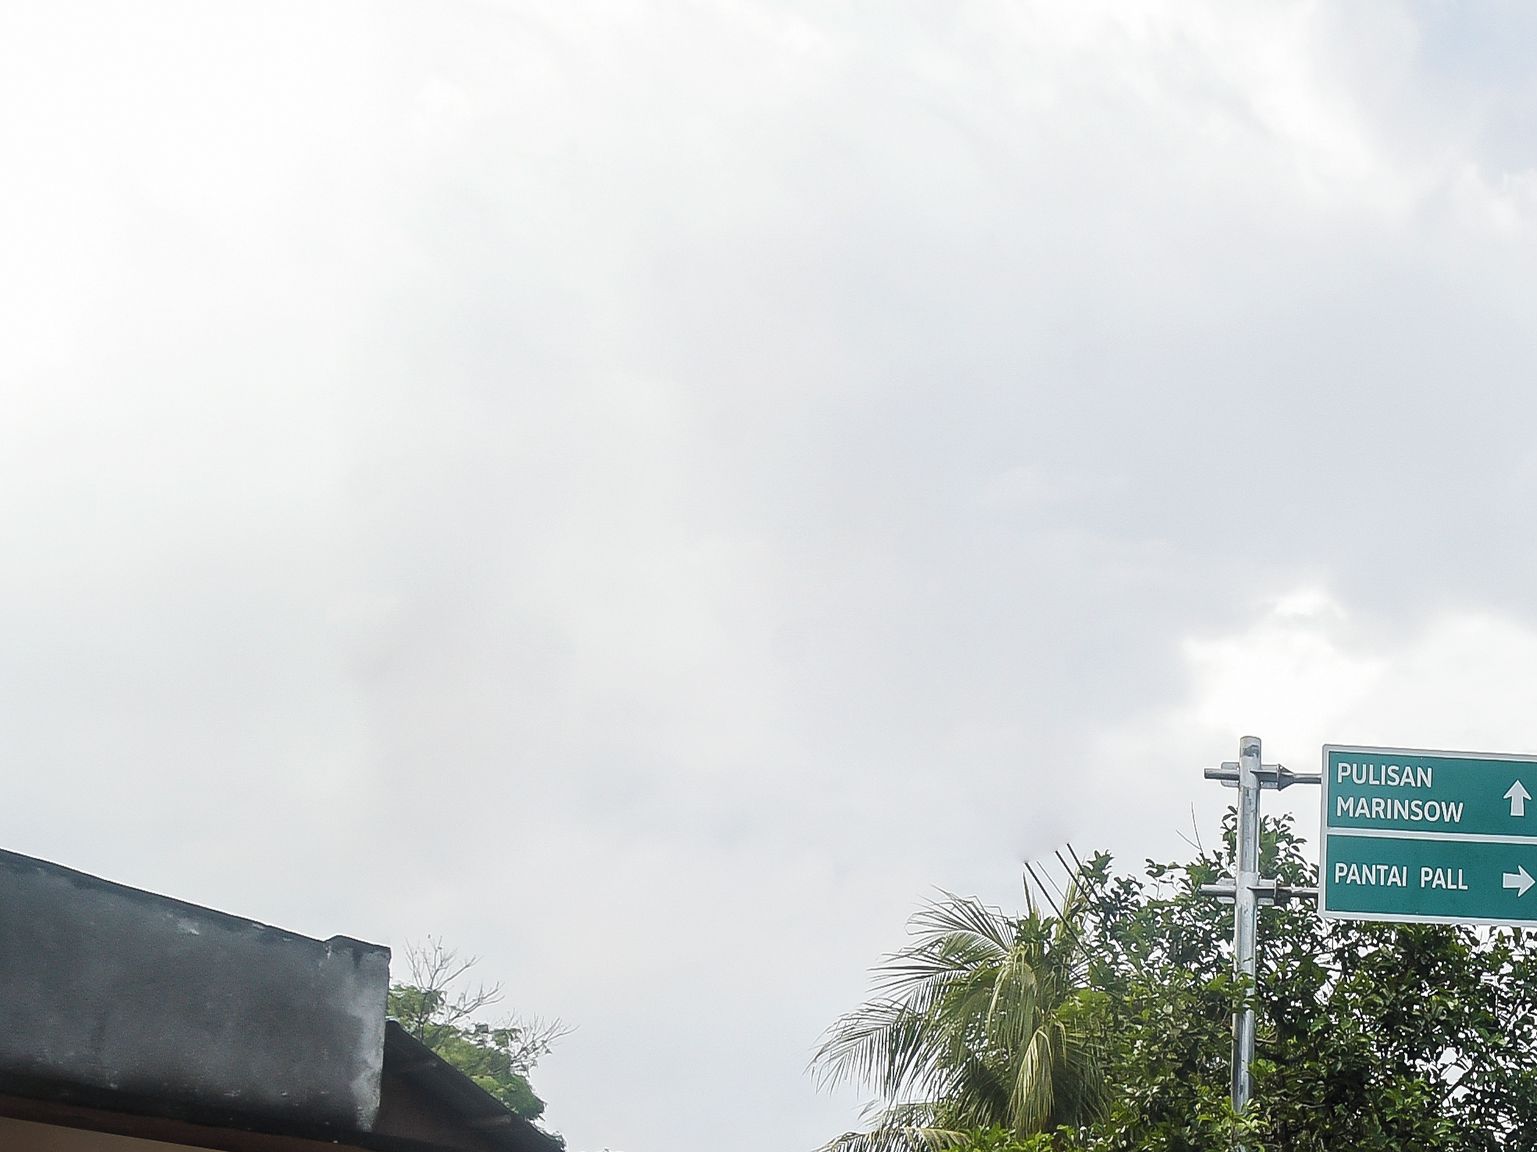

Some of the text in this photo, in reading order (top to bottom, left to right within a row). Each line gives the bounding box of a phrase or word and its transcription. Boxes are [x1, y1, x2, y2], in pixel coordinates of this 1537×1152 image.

[1336, 762, 1433, 788] PULISAN
[1336, 796, 1464, 823] MARINSOW
[1334, 862, 1469, 890] PANTAI PALL
